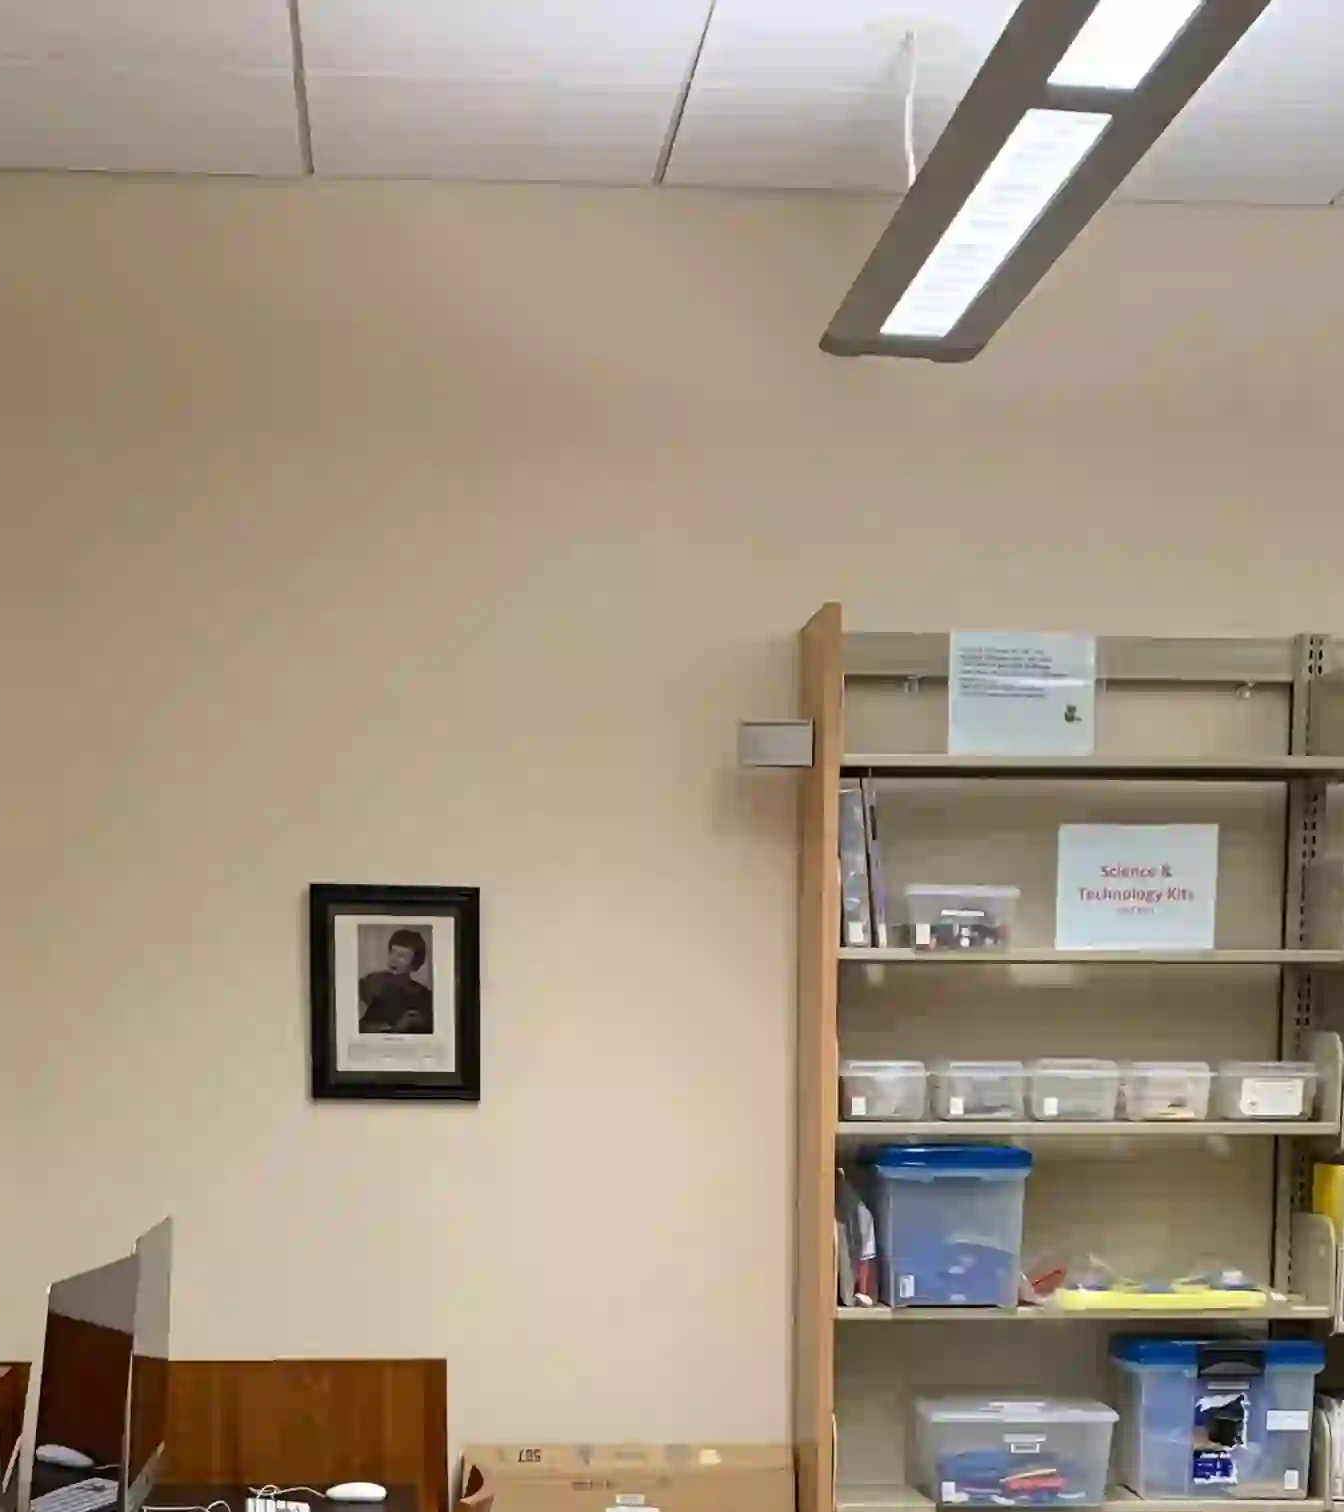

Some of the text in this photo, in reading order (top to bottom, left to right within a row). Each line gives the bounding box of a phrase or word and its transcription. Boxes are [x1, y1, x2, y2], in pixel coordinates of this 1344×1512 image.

[1099, 862, 1156, 878] Science
[1079, 886, 1194, 903] Technology Kits
